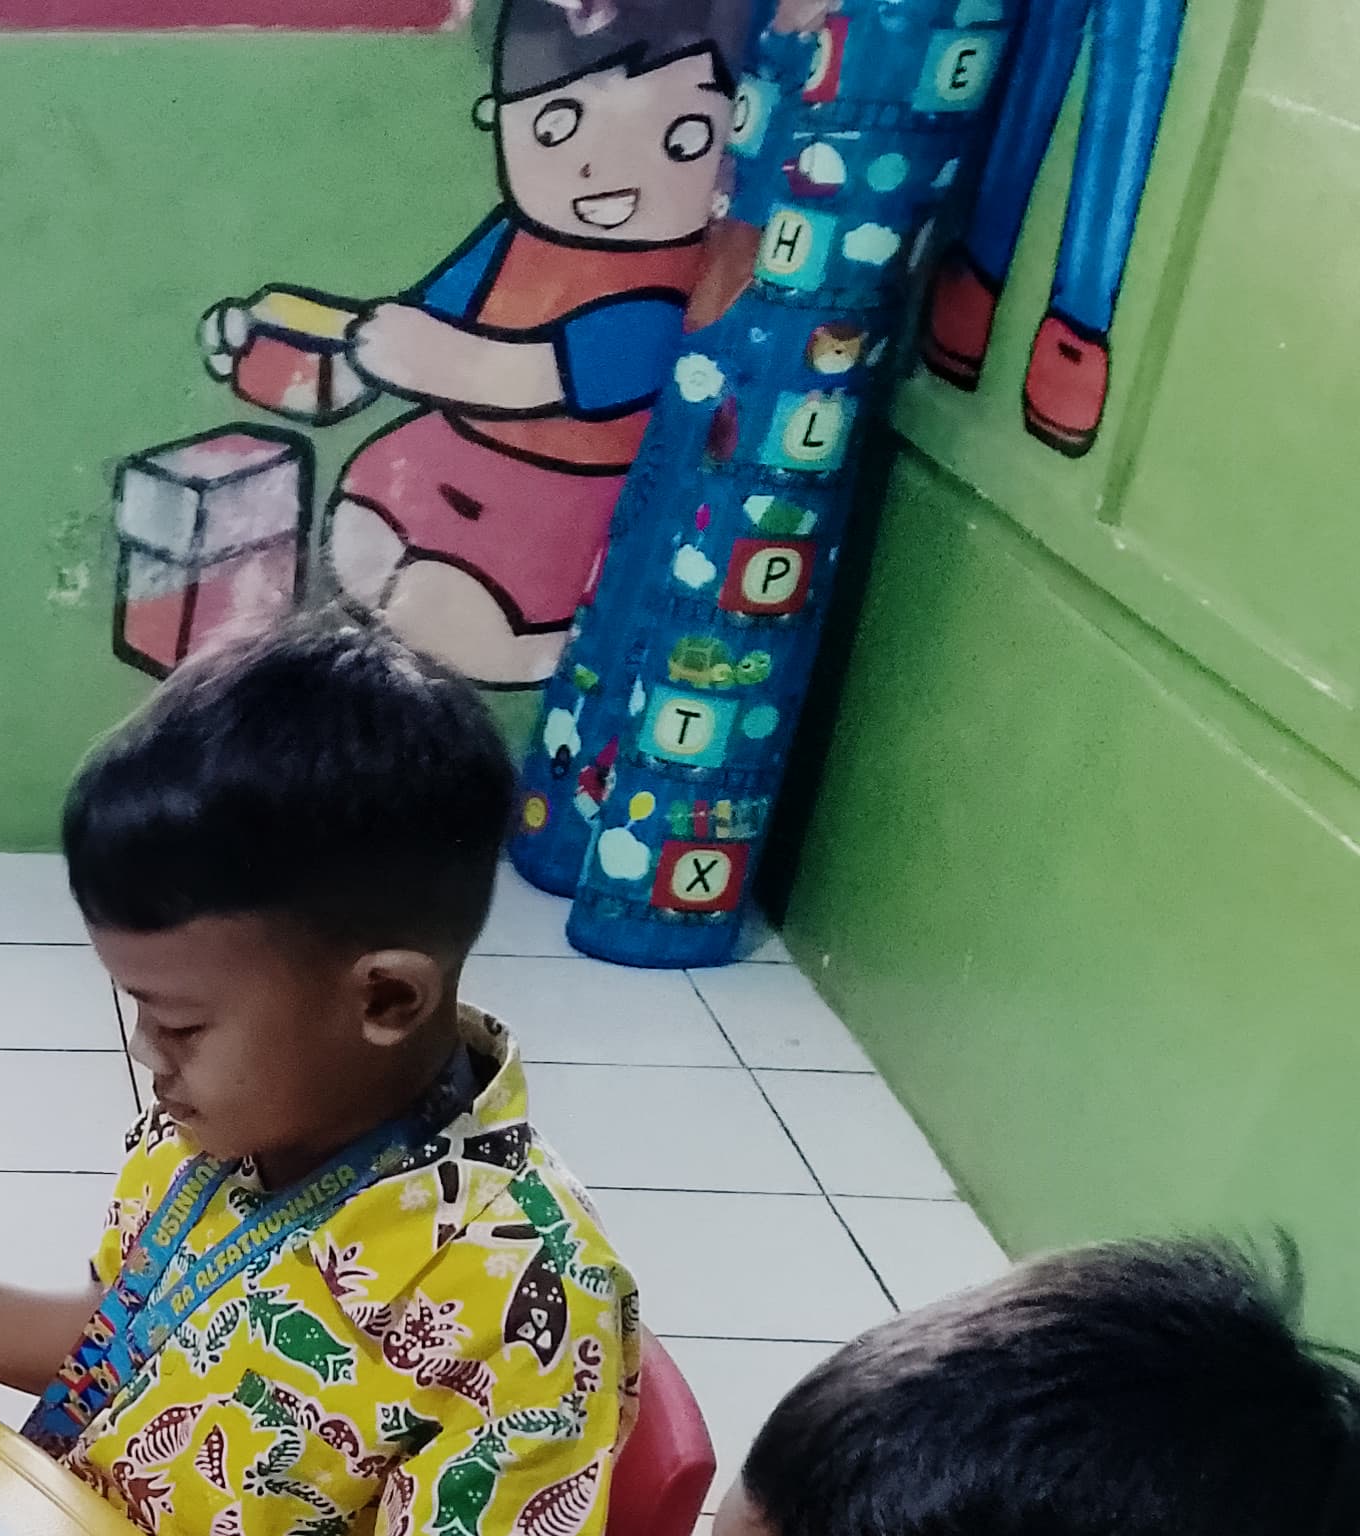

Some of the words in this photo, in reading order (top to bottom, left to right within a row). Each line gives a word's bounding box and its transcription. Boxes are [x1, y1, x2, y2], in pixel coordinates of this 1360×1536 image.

[949, 49, 977, 90] E
[772, 220, 803, 263] H
[800, 411, 824, 450] L
[761, 556, 791, 594] P
[675, 708, 701, 745] T
[685, 857, 719, 893] X
[170, 1286, 195, 1316] RA
[196, 1164, 356, 1290] ALFATHUNNISA
